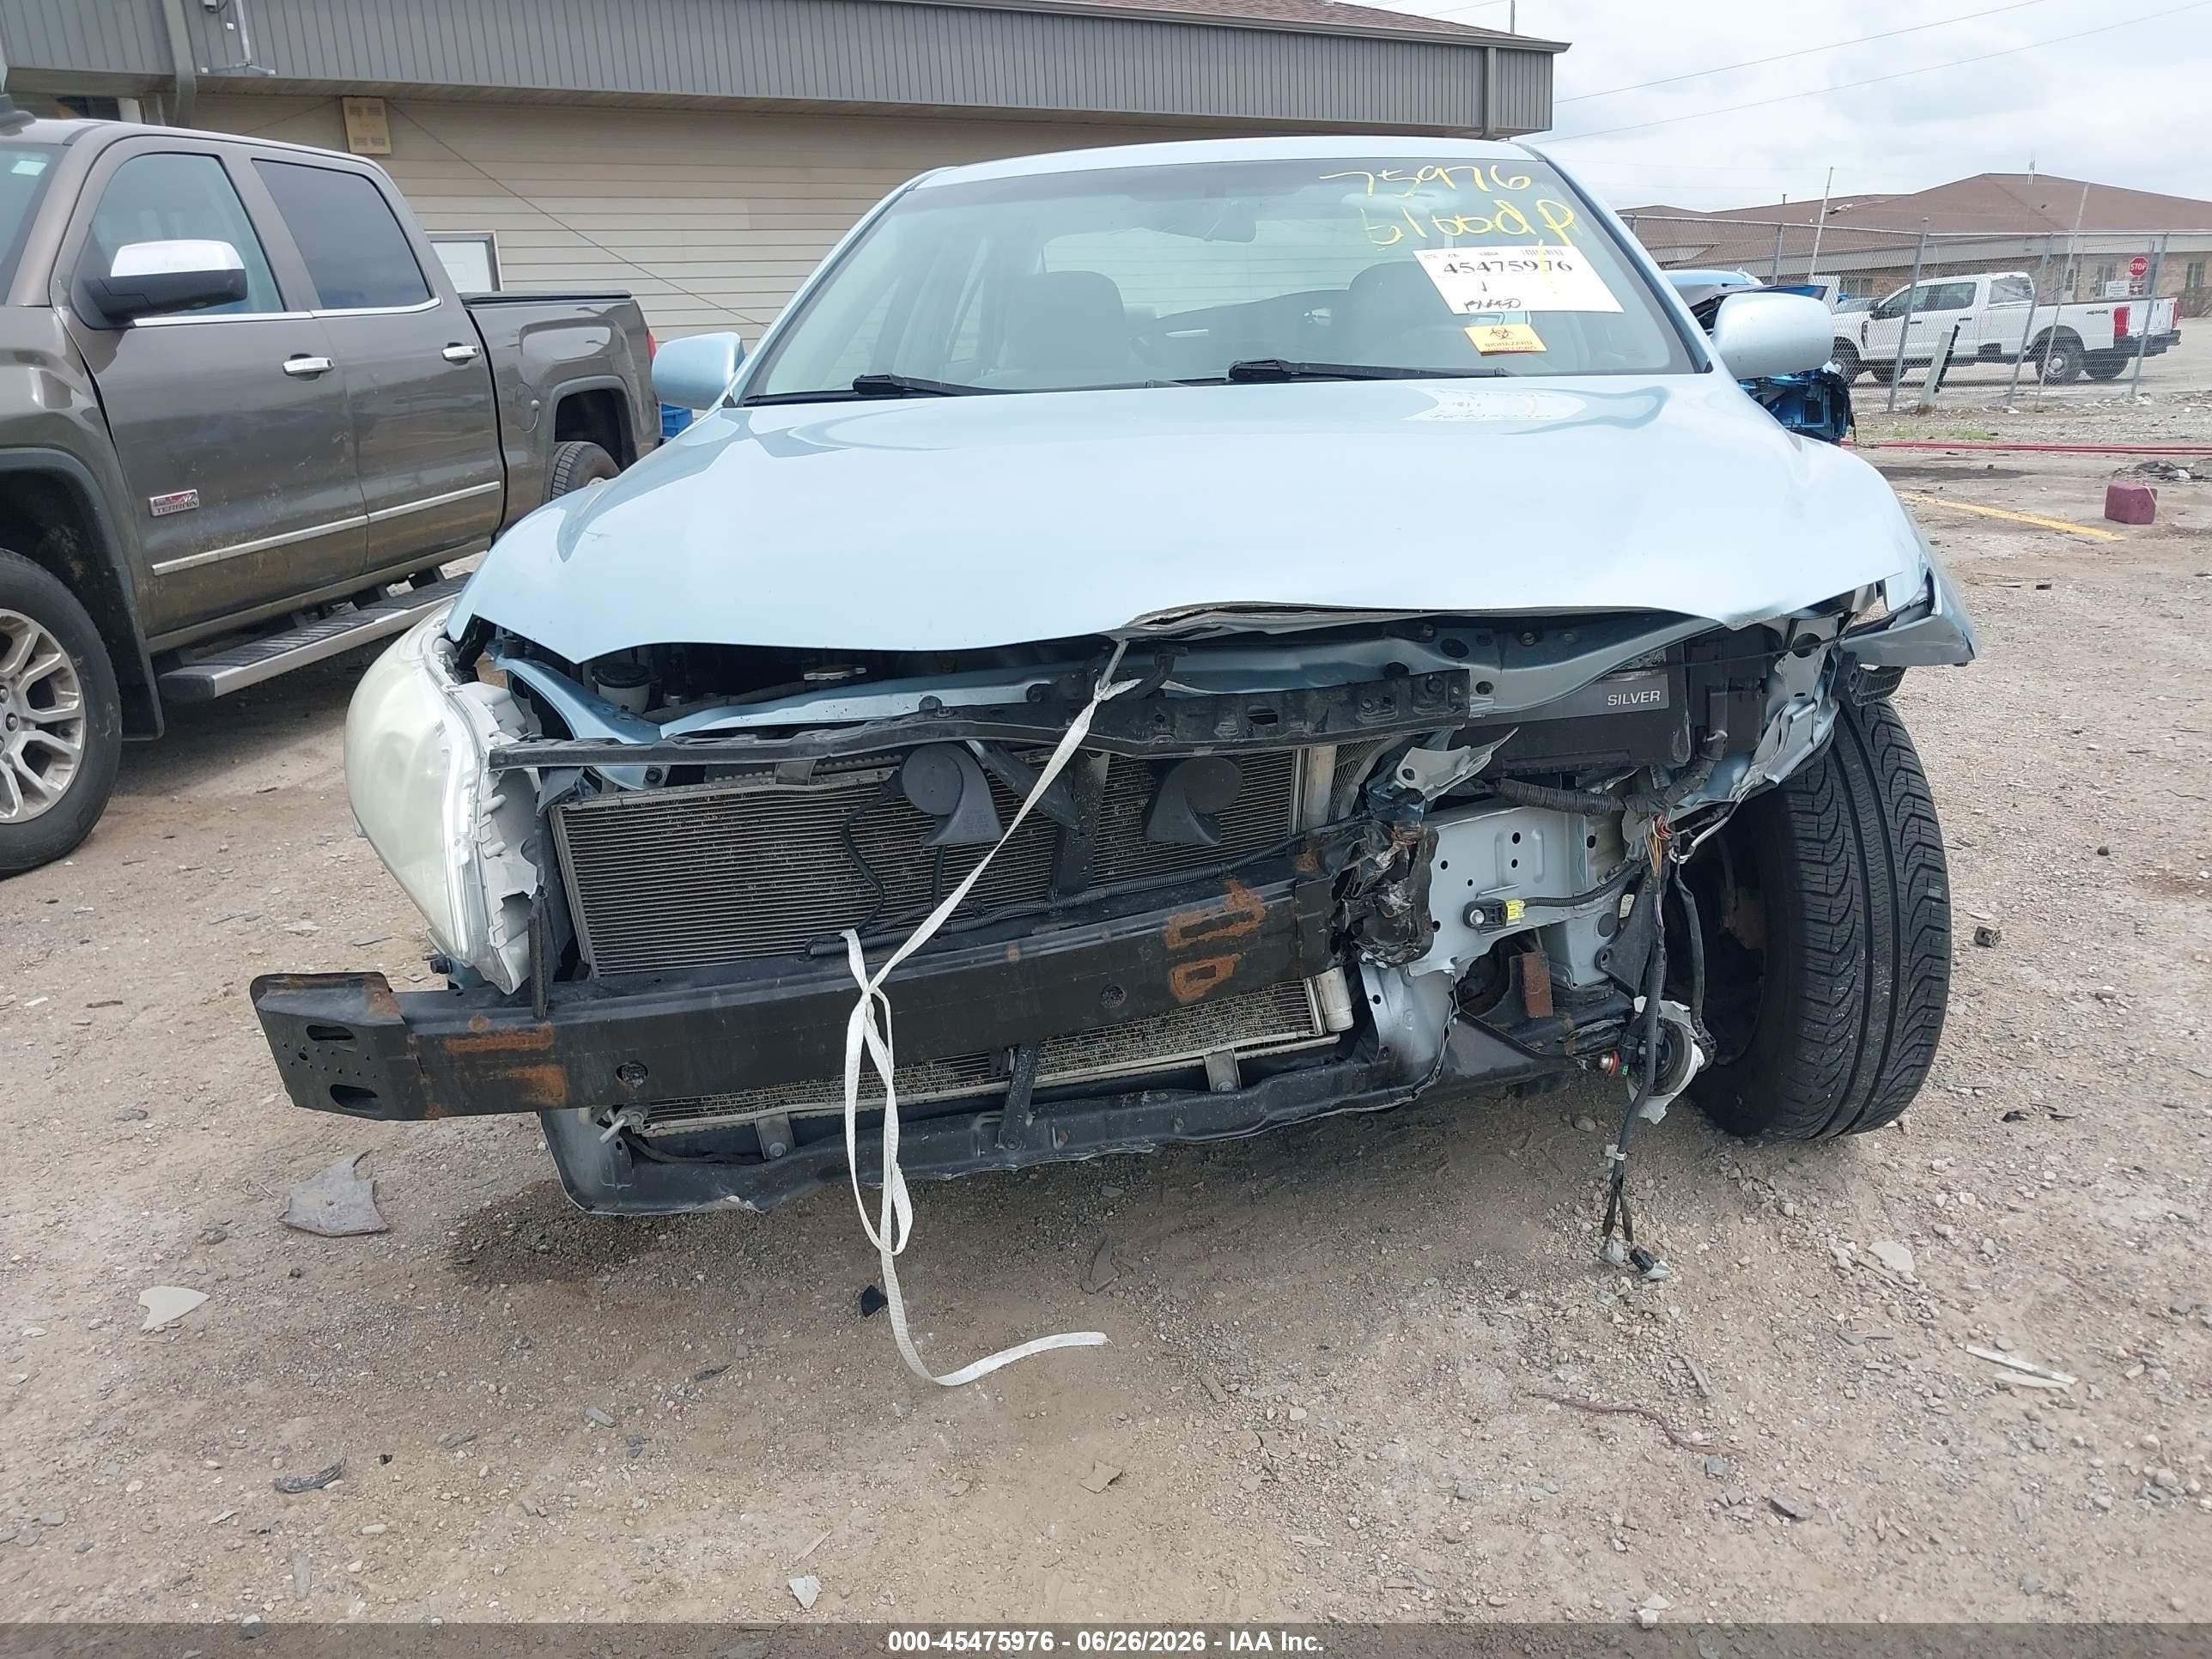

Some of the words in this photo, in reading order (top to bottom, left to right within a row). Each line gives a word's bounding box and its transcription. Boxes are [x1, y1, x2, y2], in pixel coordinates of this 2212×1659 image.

[1319, 165, 1531, 198] 75976
[1443, 259, 1573, 275] 45475976
[2130, 262, 2147, 270] STOP
[157, 501, 198, 514] TERRAIN
[1607, 690, 1661, 707] SILVER
